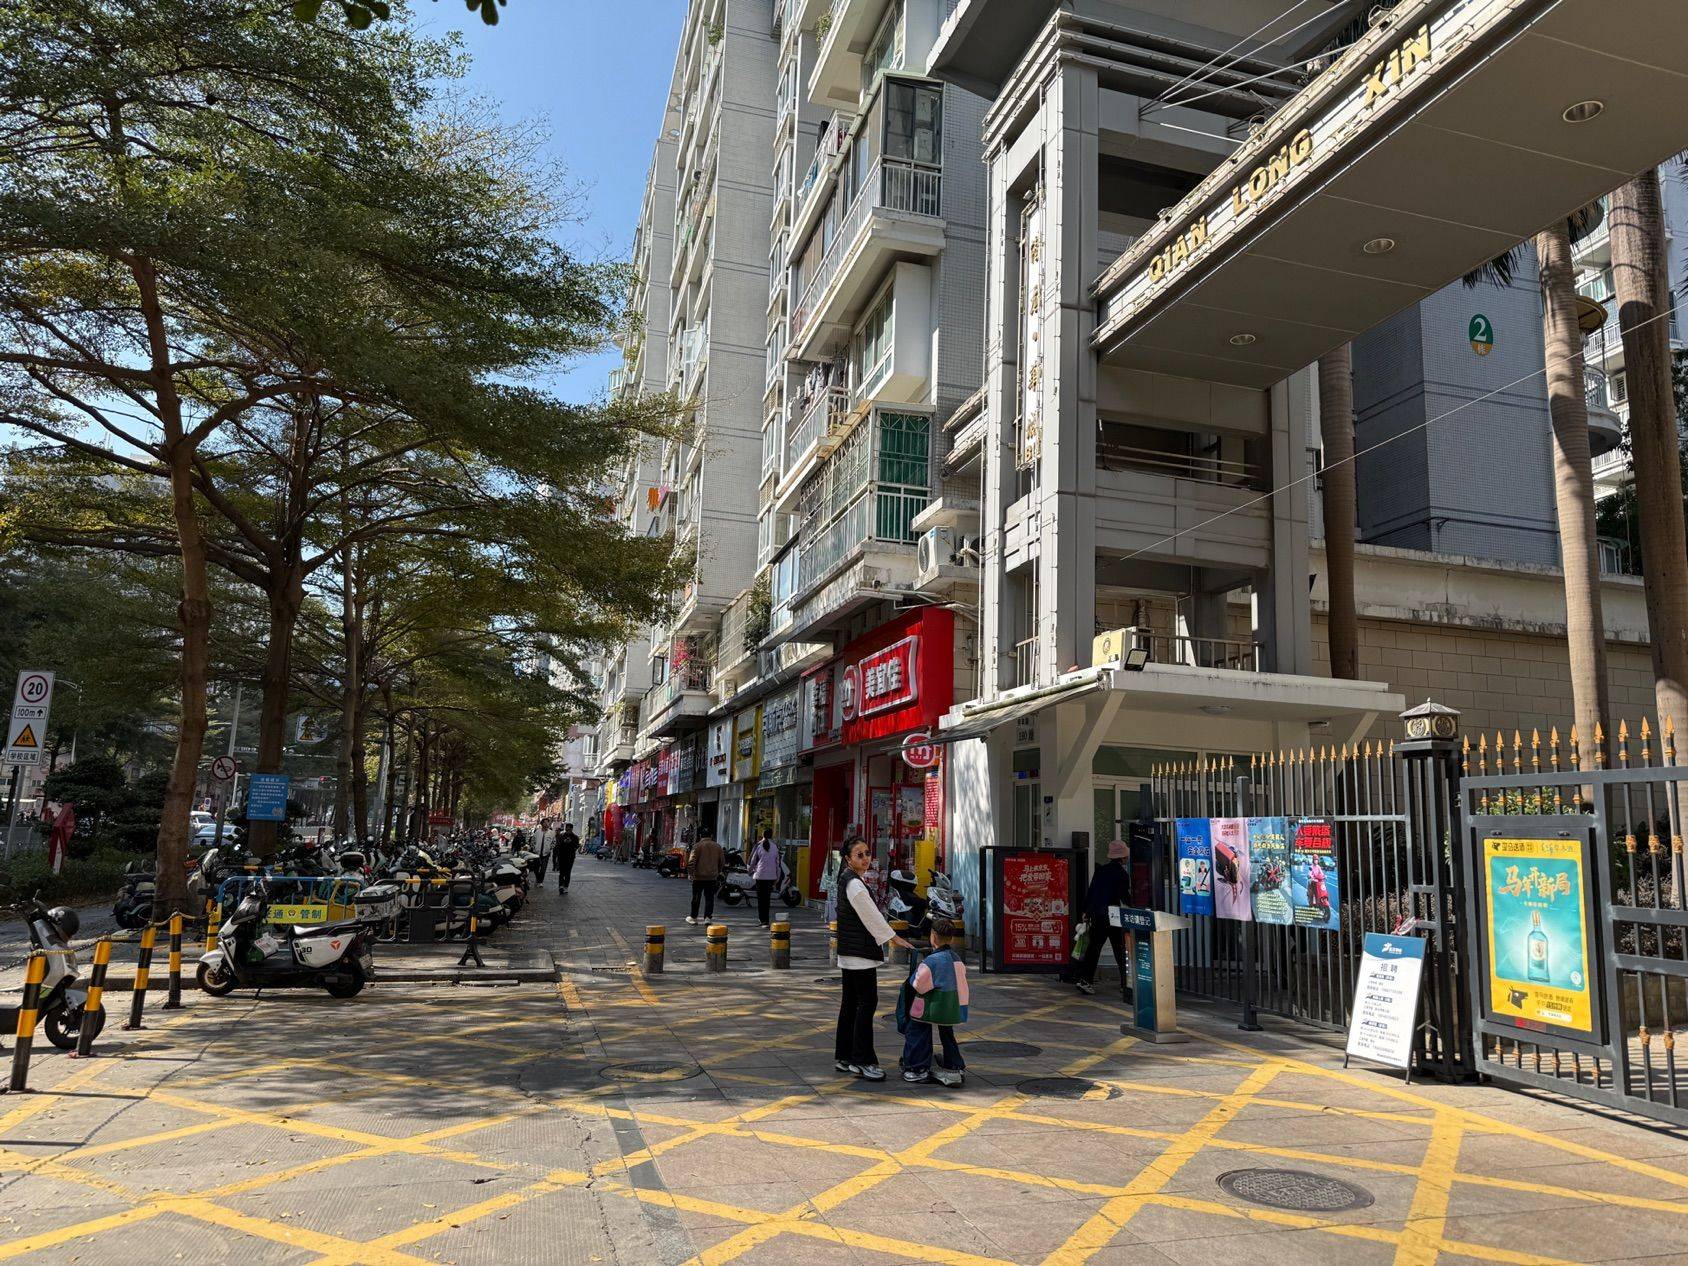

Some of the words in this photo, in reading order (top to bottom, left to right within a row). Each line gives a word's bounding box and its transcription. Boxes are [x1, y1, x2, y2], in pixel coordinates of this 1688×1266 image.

[1148, 195, 1208, 283] QIAN
[1232, 128, 1314, 216] LONG
[1361, 23, 1432, 107] XIN
[1473, 317, 1487, 342] 2
[865, 657, 901, 699] 美宜佳
[27, 682, 43, 695] 20
[17, 708, 36, 717] 100m
[9, 752, 37, 760] 学校区域
[1380, 963, 1398, 973] 招聘
